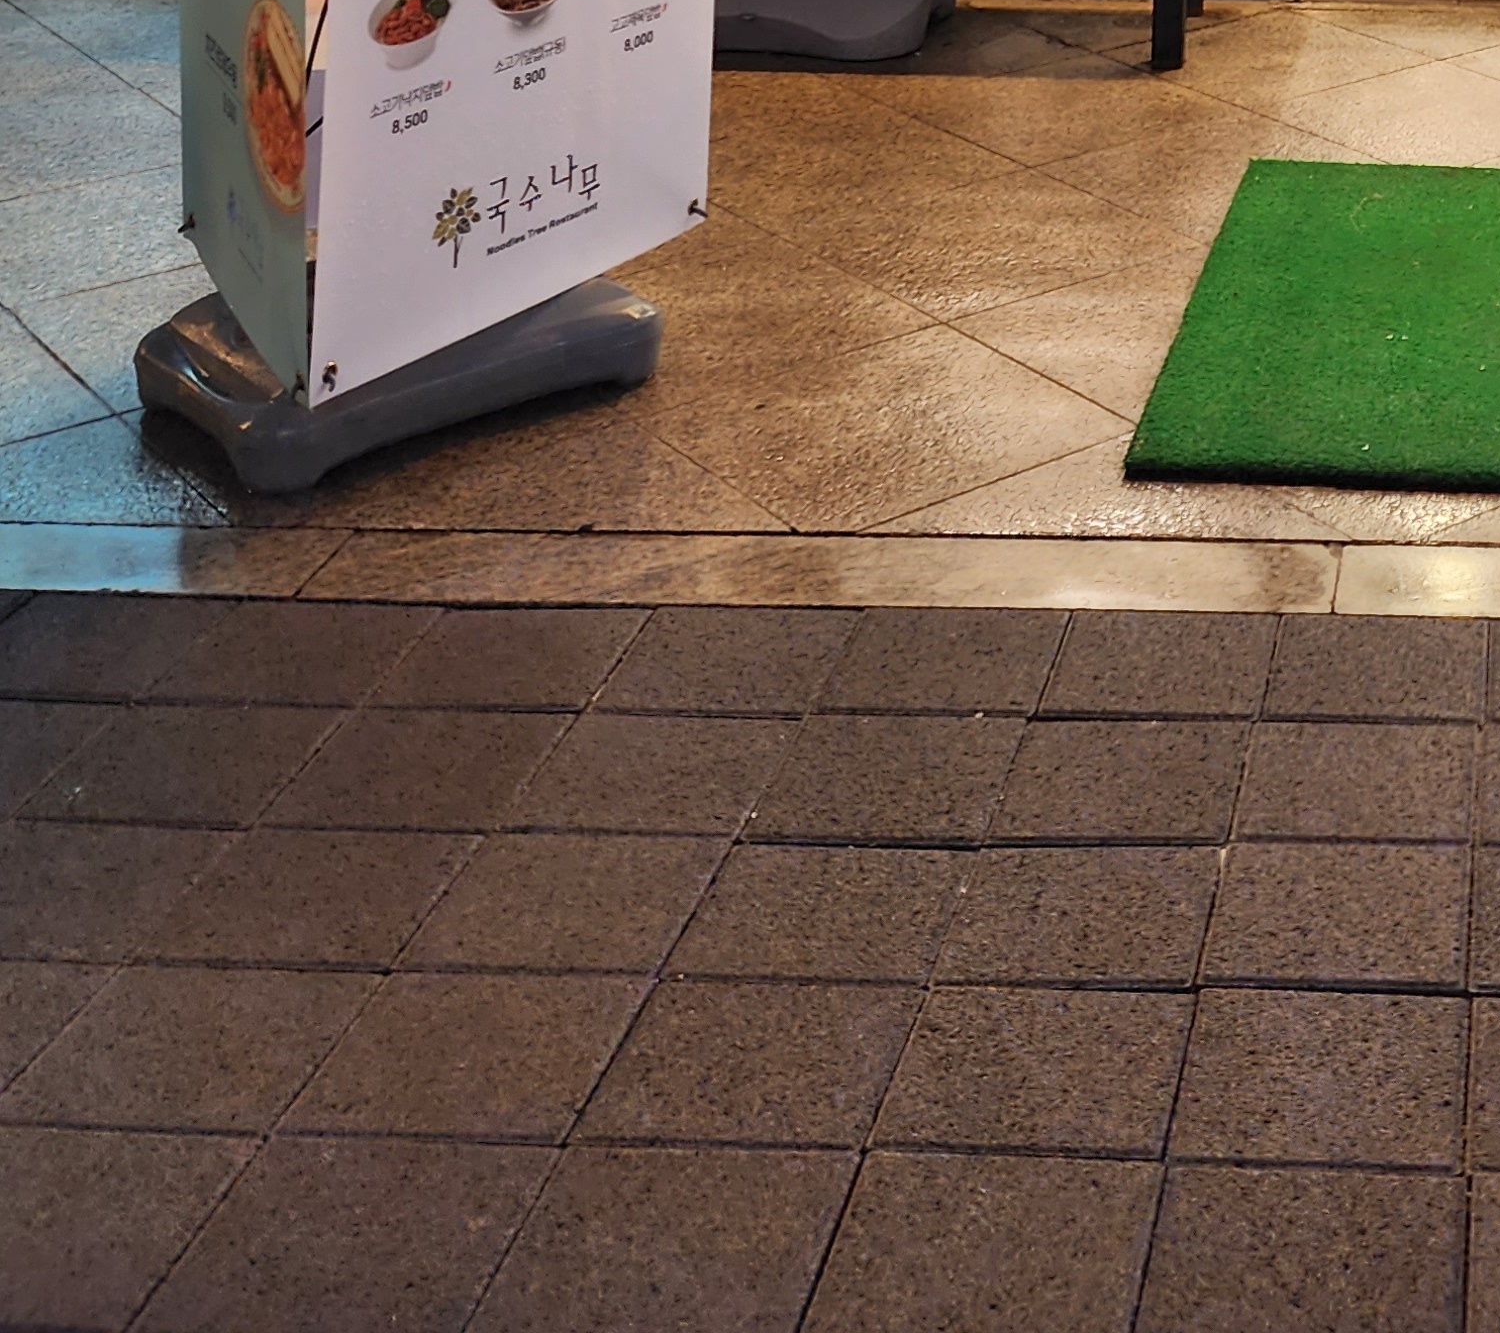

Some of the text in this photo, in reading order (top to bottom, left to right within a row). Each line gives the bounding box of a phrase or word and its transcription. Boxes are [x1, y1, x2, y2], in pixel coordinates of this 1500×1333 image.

[623, 30, 654, 53] 8,000
[512, 67, 547, 91] 8,300
[391, 108, 429, 135] 8,500
[486, 154, 601, 234] 국수나무
